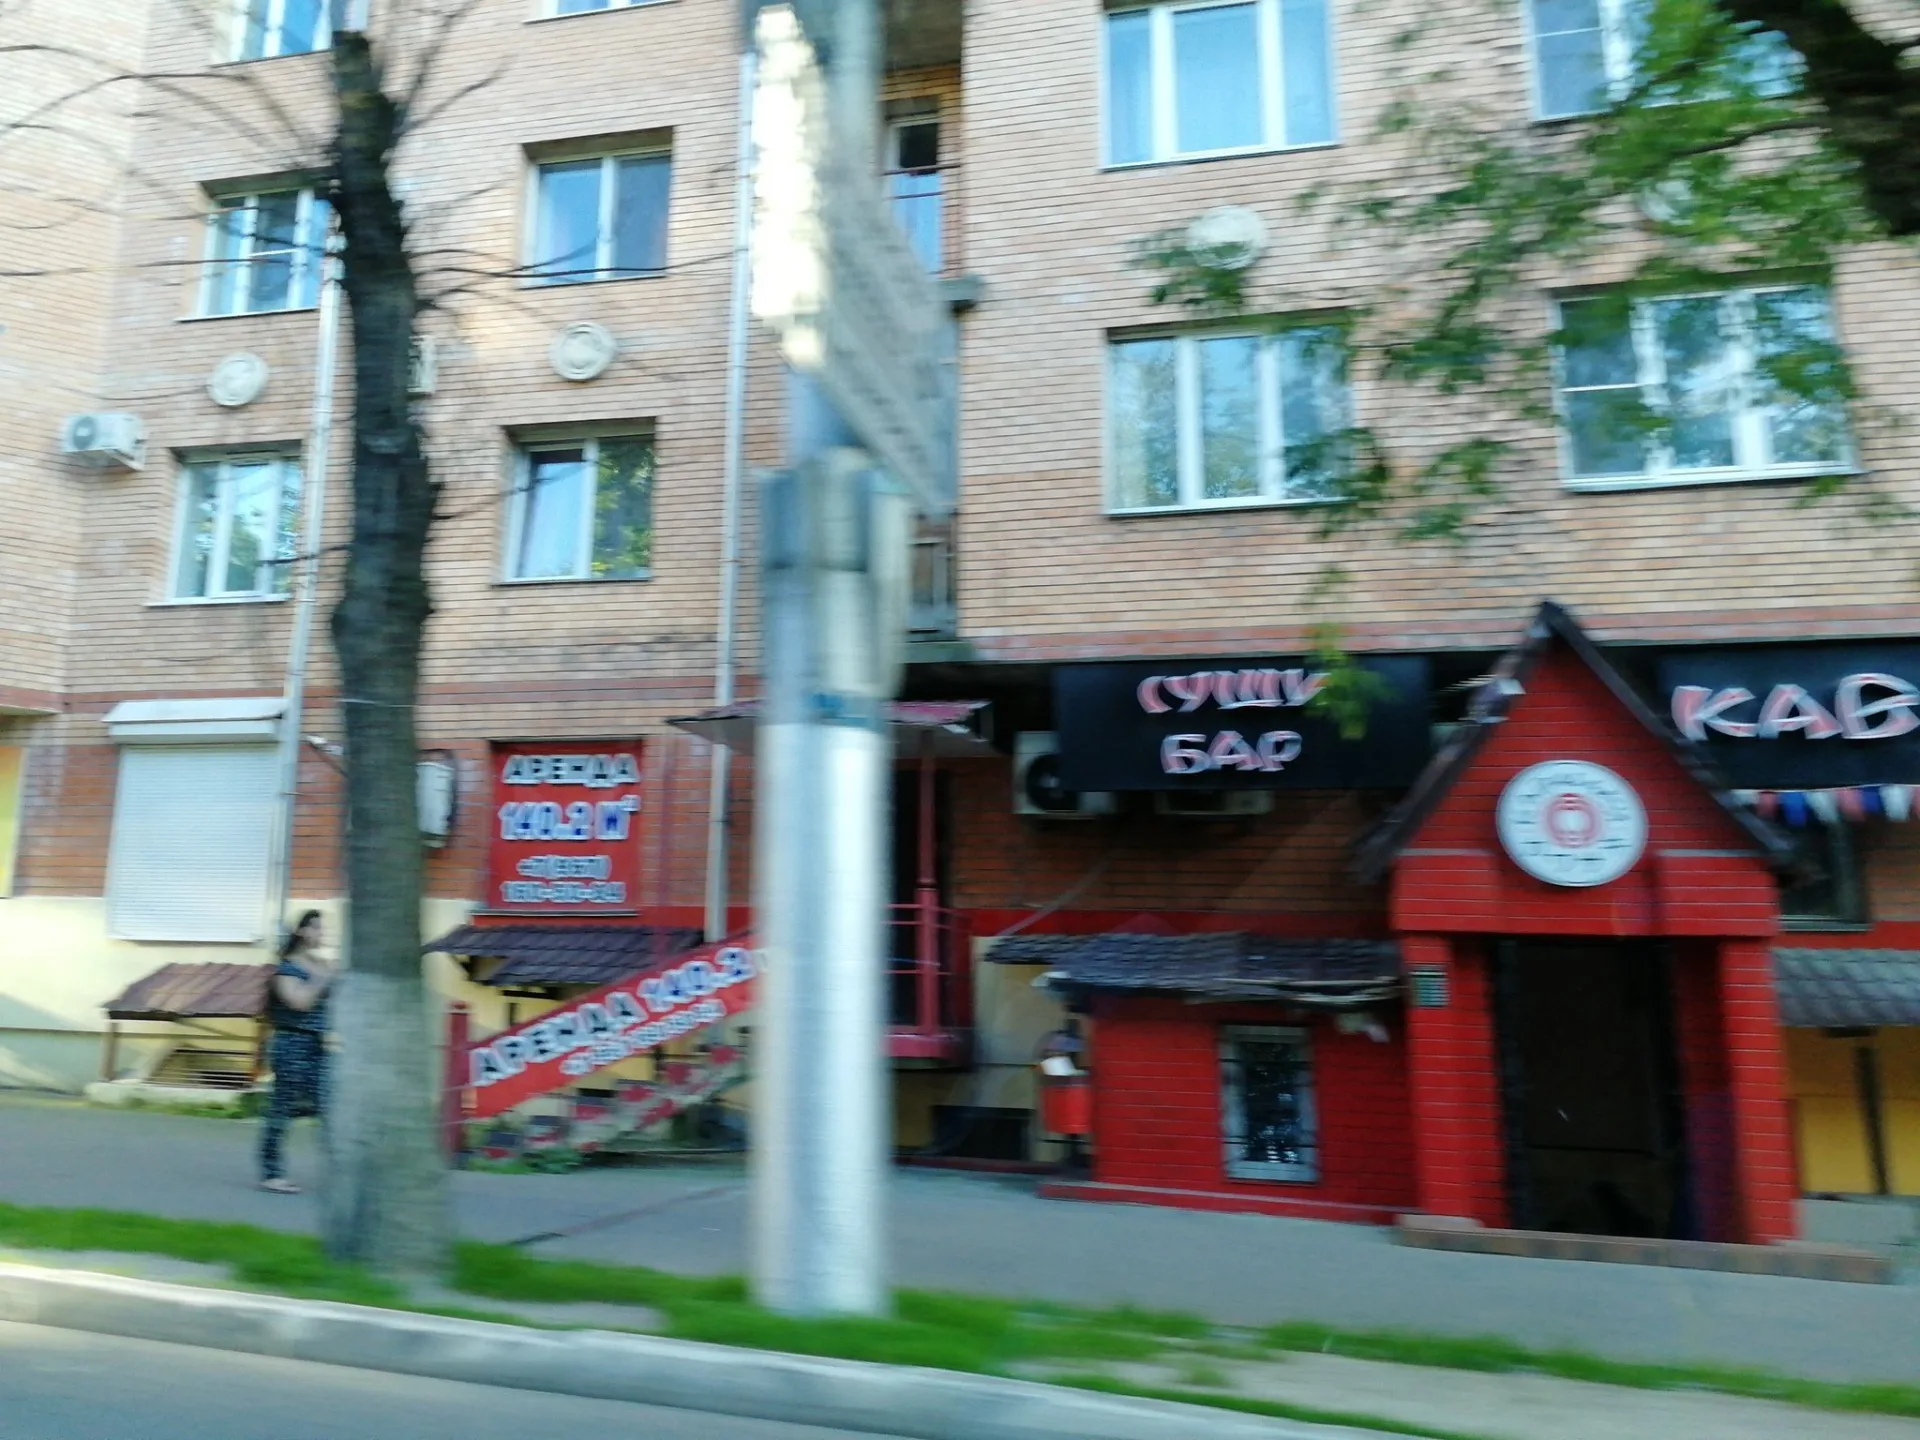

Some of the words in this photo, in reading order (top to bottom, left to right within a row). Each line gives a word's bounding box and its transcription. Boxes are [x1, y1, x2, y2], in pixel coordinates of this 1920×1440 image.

[502, 754, 641, 788] АРЕНДА
[1161, 730, 1303, 774] БАР
[470, 991, 648, 1086] АРЕНДА
